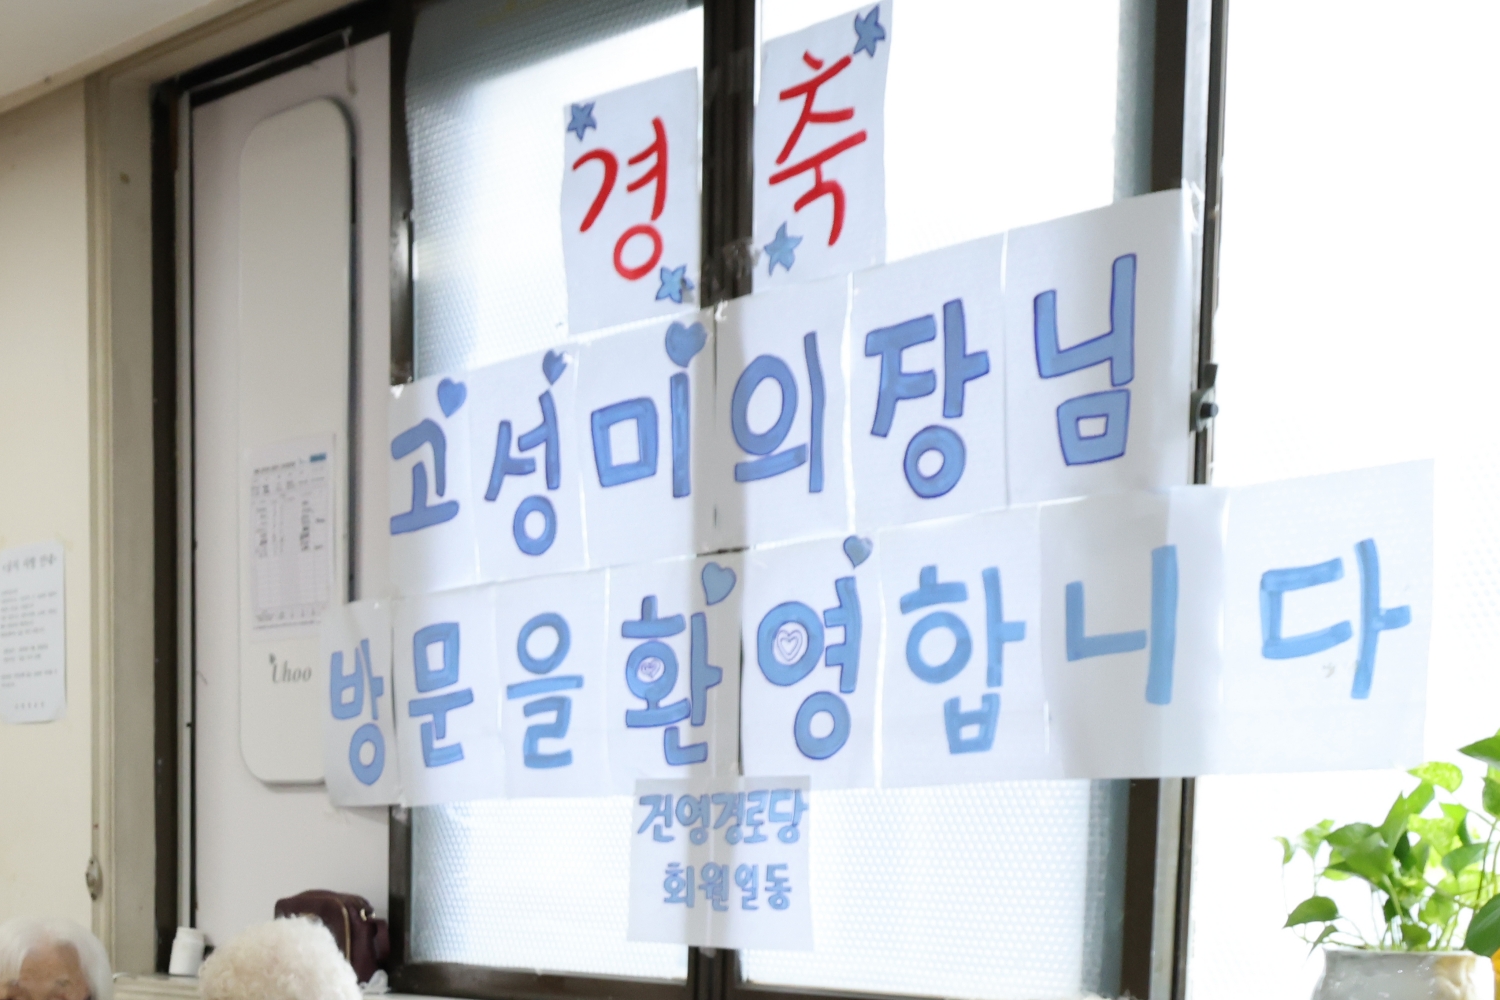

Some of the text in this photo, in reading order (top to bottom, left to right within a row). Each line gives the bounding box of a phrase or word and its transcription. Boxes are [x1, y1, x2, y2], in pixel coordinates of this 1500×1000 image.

[572, 51, 867, 281] 경축
[637, 788, 810, 846] 건영경로당
[662, 861, 792, 912] 회원일동
